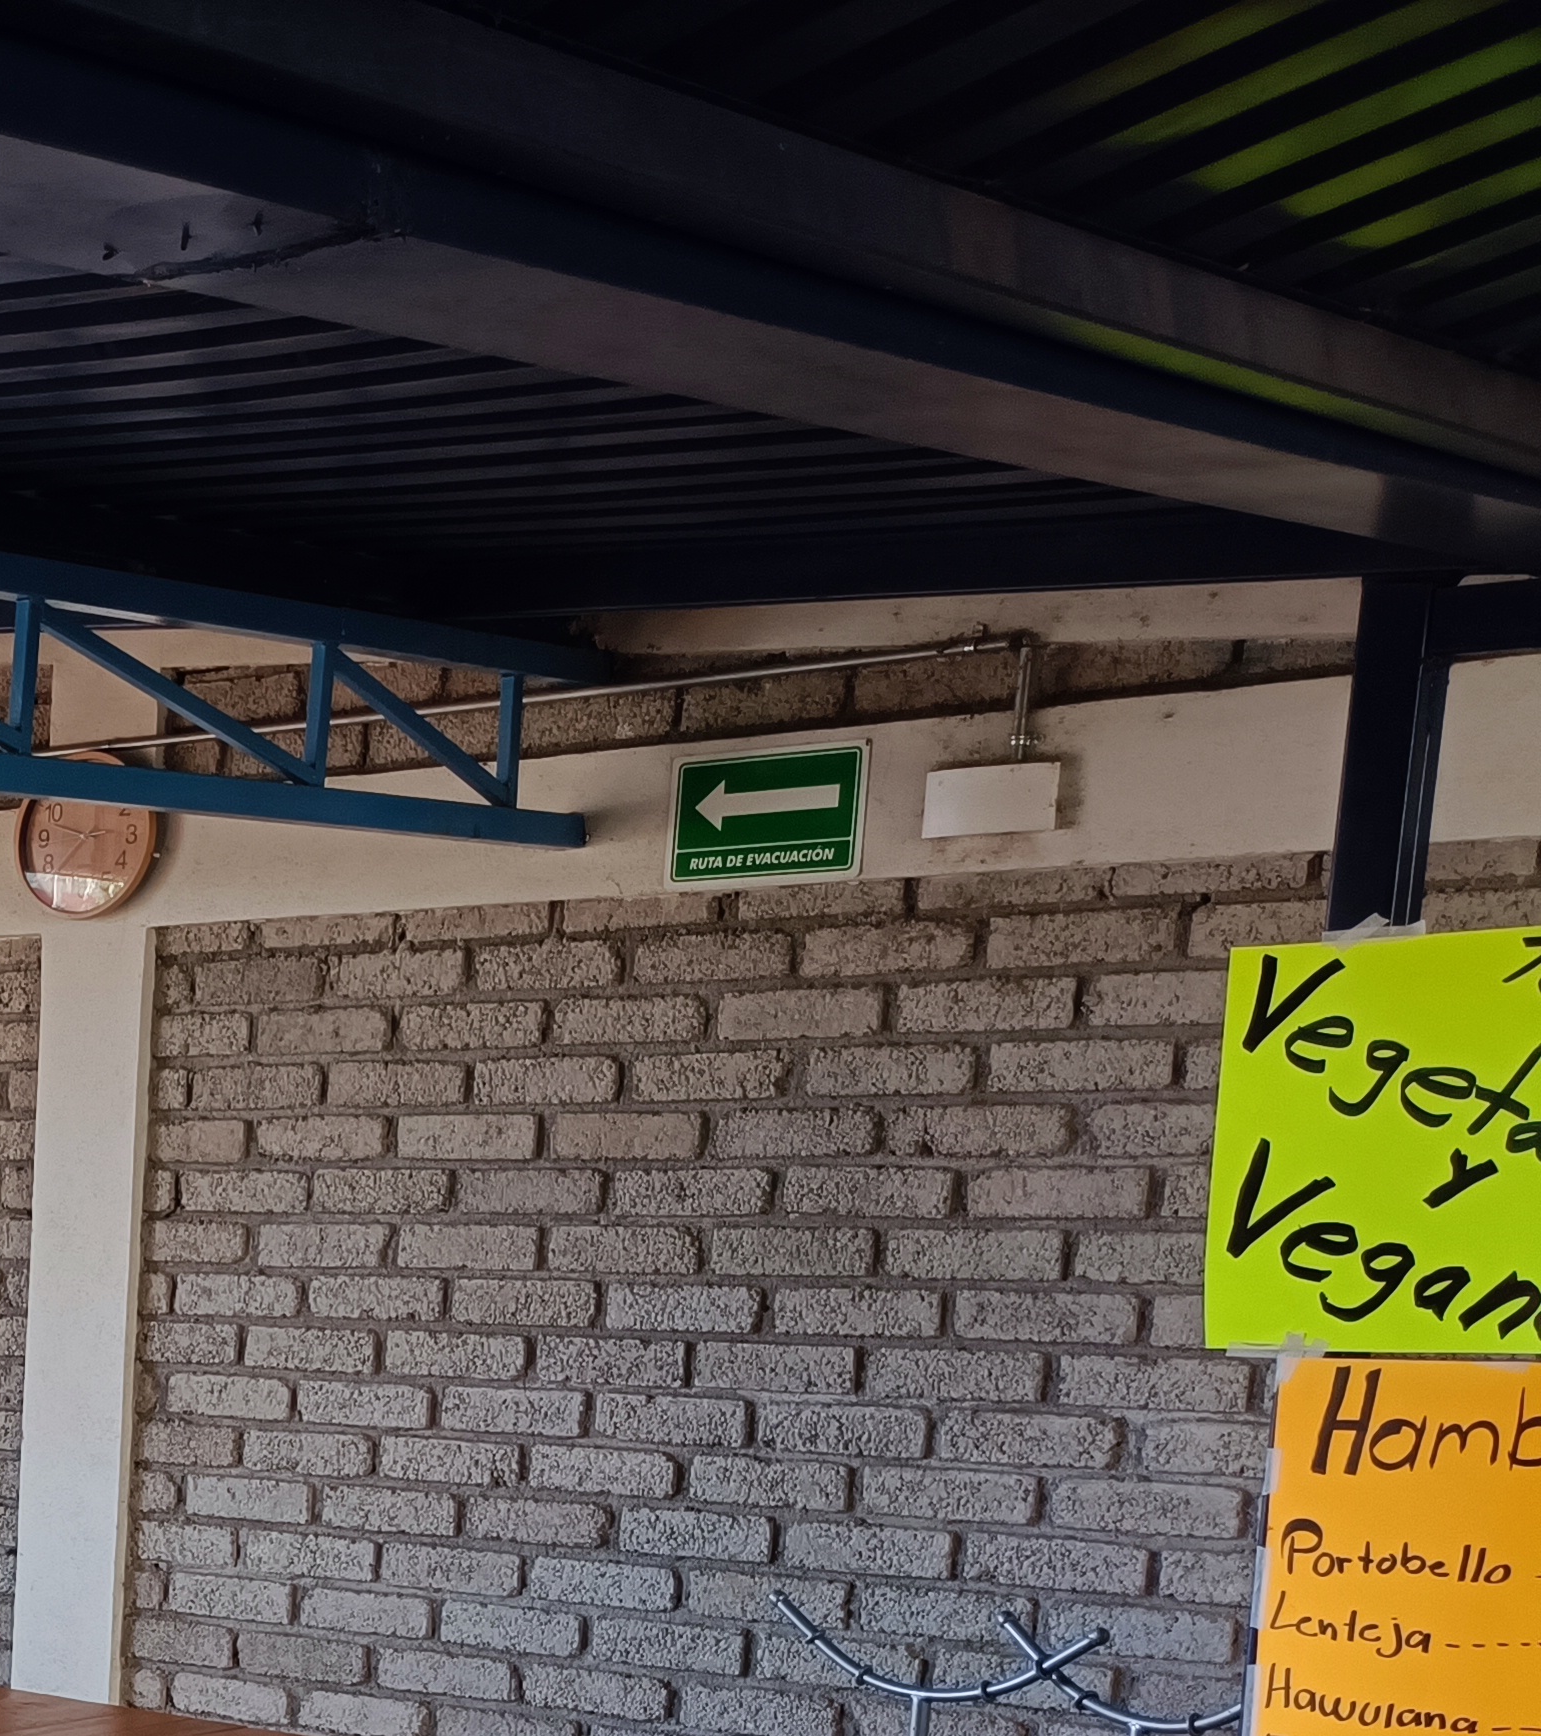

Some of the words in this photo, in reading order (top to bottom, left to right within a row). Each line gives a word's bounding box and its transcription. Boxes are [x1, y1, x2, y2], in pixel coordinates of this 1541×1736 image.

[45, 803, 63, 823] 10
[38, 829, 50, 848] 9
[125, 824, 138, 844] 3
[115, 850, 128, 870] 4
[689, 856, 723, 870] RUTA
[726, 855, 743, 867] DE
[746, 845, 835, 866] EVACUACIÓN
[1226, 1137, 1541, 1340] Vegan
[1280, 1518, 1512, 1584] Portobello
[1269, 1590, 1432, 1658] Lenteja
